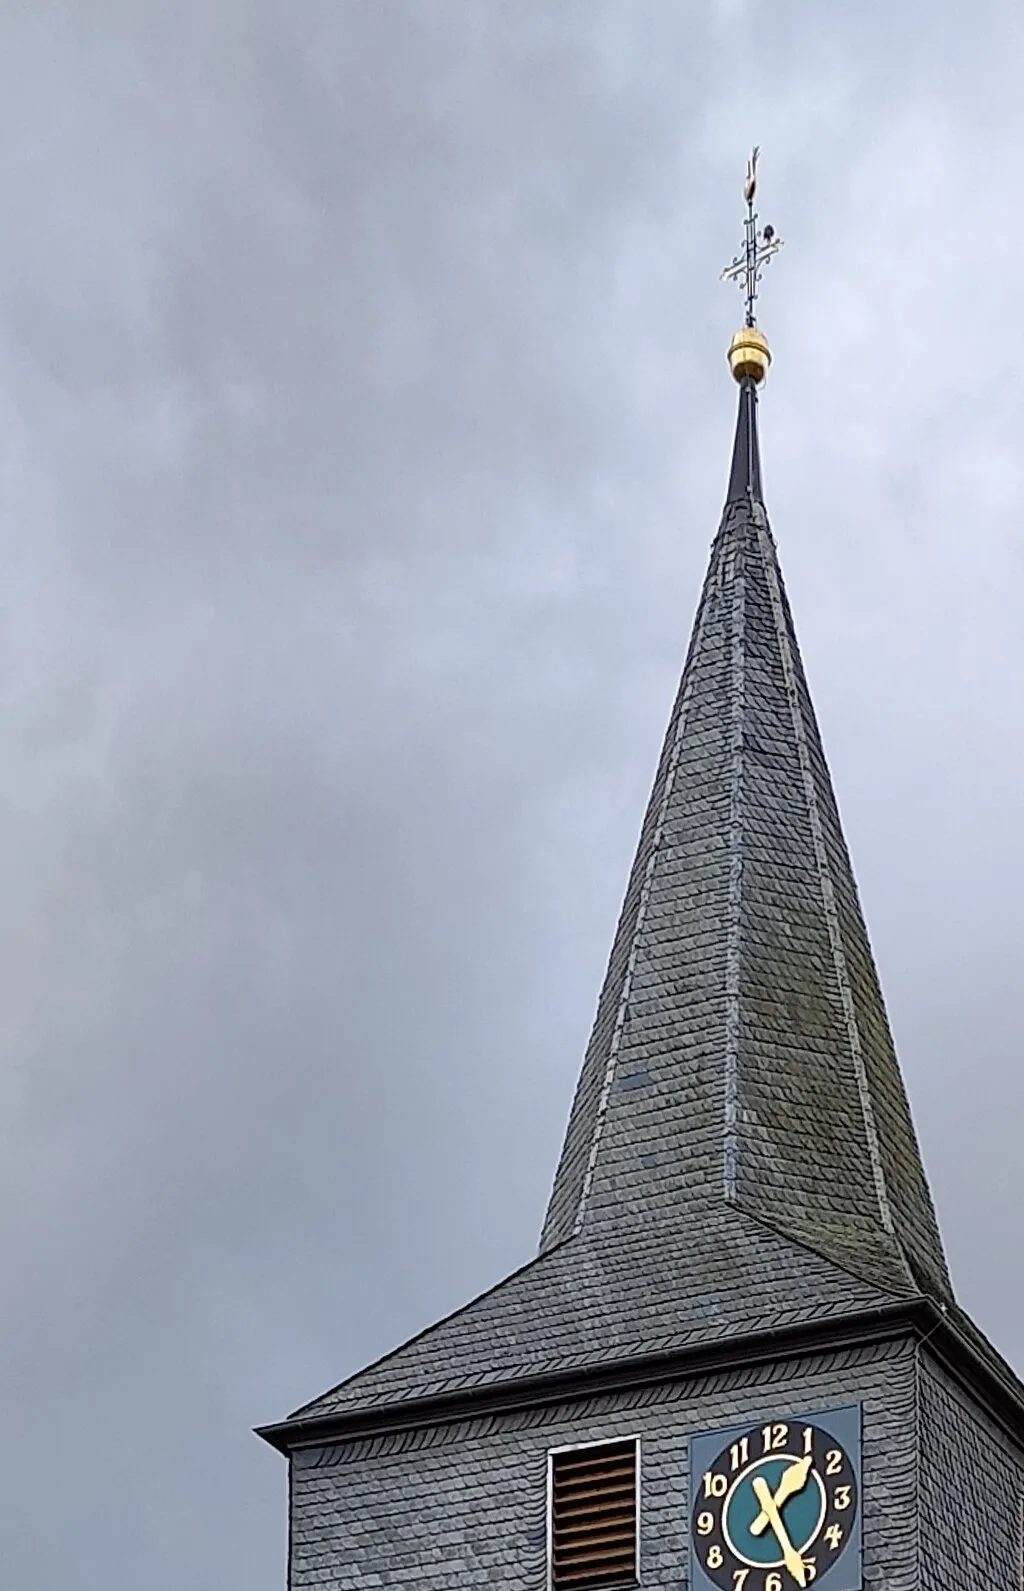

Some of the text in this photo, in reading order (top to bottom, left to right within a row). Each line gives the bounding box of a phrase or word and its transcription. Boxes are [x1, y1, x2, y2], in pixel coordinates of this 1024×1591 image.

[762, 1424, 788, 1453] 12
[803, 1427, 813, 1453] 1
[730, 1437, 749, 1471] 11
[826, 1450, 842, 1475] 2
[703, 1472, 728, 1498] 10
[834, 1486, 851, 1510] 3
[697, 1512, 714, 1535] 9
[824, 1524, 843, 1550] 4
[706, 1545, 723, 1569] 8
